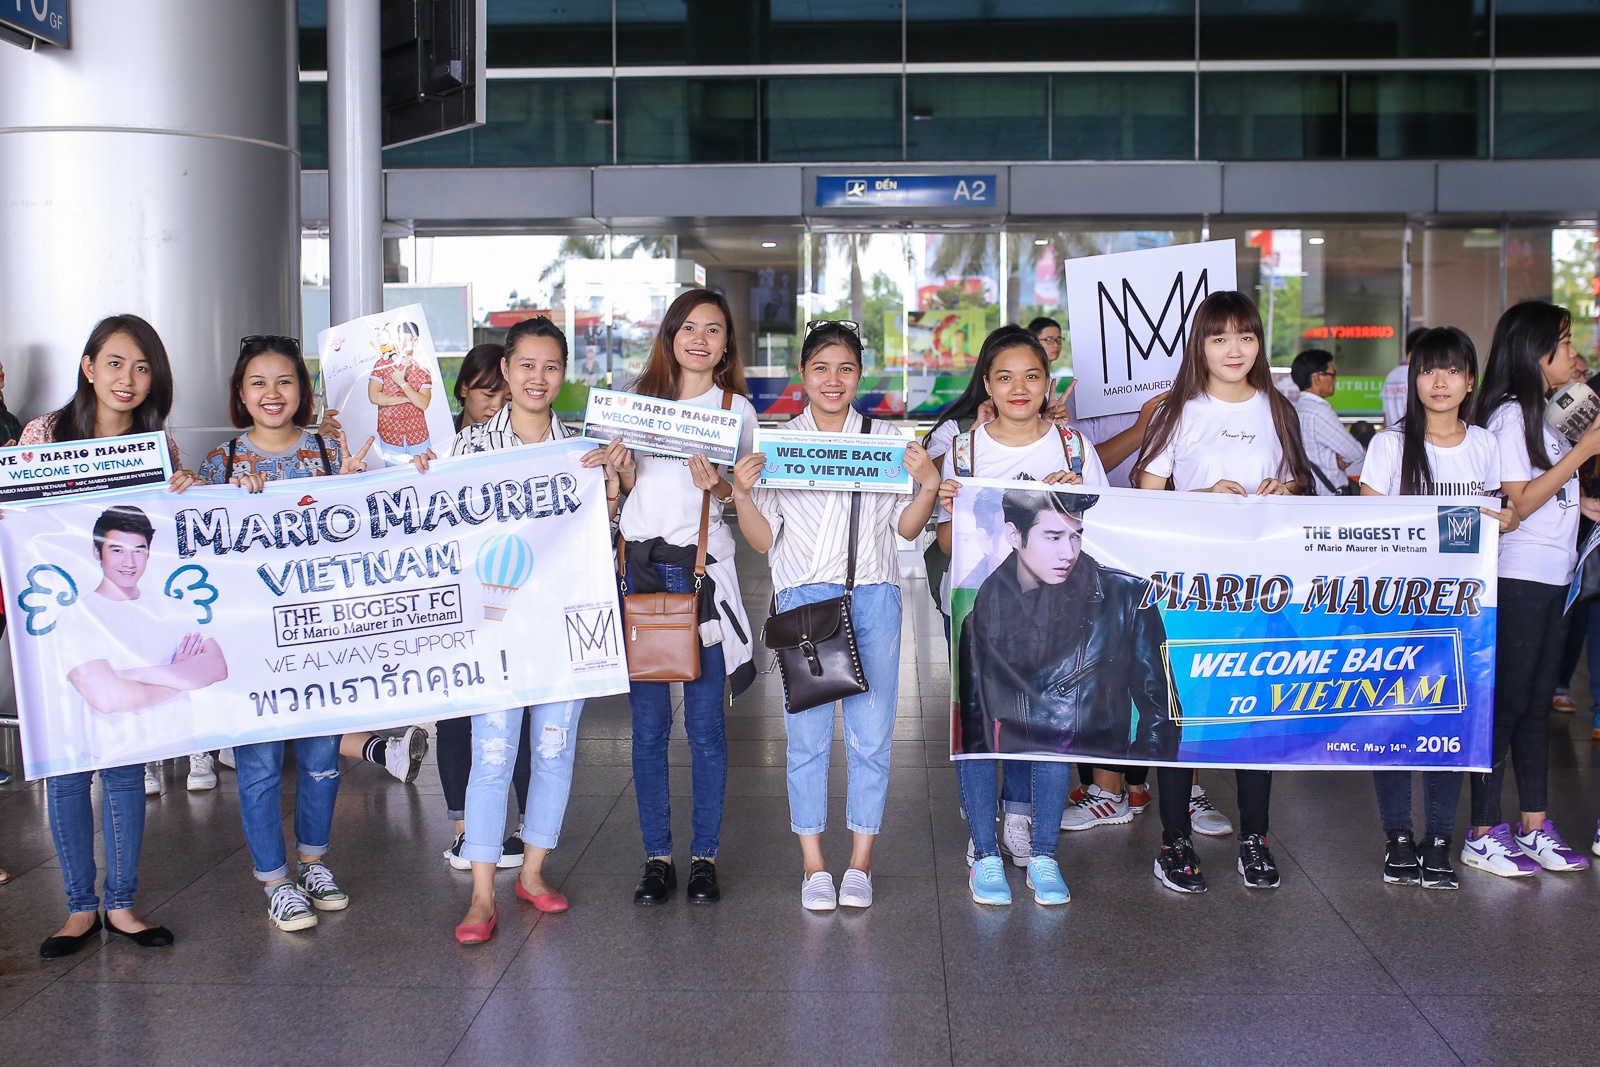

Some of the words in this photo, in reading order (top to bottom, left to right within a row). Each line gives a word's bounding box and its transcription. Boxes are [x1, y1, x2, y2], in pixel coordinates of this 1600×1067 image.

[50, 12, 62, 30] GF
[953, 180, 986, 201] A2
[1103, 385, 1133, 396] MARIO
[1134, 380, 1172, 392] MAURER
[594, 395, 613, 406] WE
[631, 401, 676, 417] MARIO
[681, 410, 738, 428] MAURER
[601, 410, 654, 428] WELCOME
[657, 420, 672, 431] TO
[675, 423, 721, 440] VIETNAM
[40, 449, 89, 462] MARIO
[95, 441, 156, 456] MAURER
[623, 430, 646, 440] VIETNAM
[665, 438, 682, 446] MARIO
[710, 445, 734, 455] VIETNAM
[776, 446, 848, 460] WELCOME
[851, 450, 893, 462] BACK
[9, 466, 70, 480] WELCOME
[73, 463, 89, 474] TO
[93, 457, 144, 470] VIETNAM
[137, 470, 163, 478] VIETNAM
[784, 463, 806, 474] TO
[810, 465, 879, 477] VIETNAM
[175, 504, 361, 559] MARIO
[367, 472, 582, 538] MAURER
[1303, 526, 1331, 540] THE
[1338, 526, 1401, 540] BIGGEST
[1408, 528, 1426, 540] FC
[1305, 544, 1313, 552] of
[1317, 544, 1342, 552] Mario
[1346, 544, 1377, 552] Maurer
[1392, 544, 1427, 553] Vietnam
[257, 540, 463, 596] VIETNAM
[1138, 571, 1294, 614] MARIO
[1300, 576, 1486, 617] MAURER
[279, 606, 323, 628] THE
[333, 594, 420, 622] BIGGEST
[429, 590, 456, 610] FC
[282, 628, 299, 642] Of
[303, 625, 340, 639] Mario
[344, 620, 388, 634] Maurer
[392, 617, 403, 627] in
[408, 609, 457, 625] Vietnam
[265, 655, 297, 673] WE
[394, 629, 476, 656] SUPPORT
[1189, 649, 1333, 678] WELCOME
[1341, 645, 1424, 673] BACK
[249, 662, 485, 717] พวกเรารักคุณ
[1228, 696, 1257, 715] TO
[1270, 674, 1448, 713] VIETNAM
[1326, 742, 1359, 752] HCMC,
[1363, 743, 1385, 754] May
[1415, 736, 1461, 753] 2016
